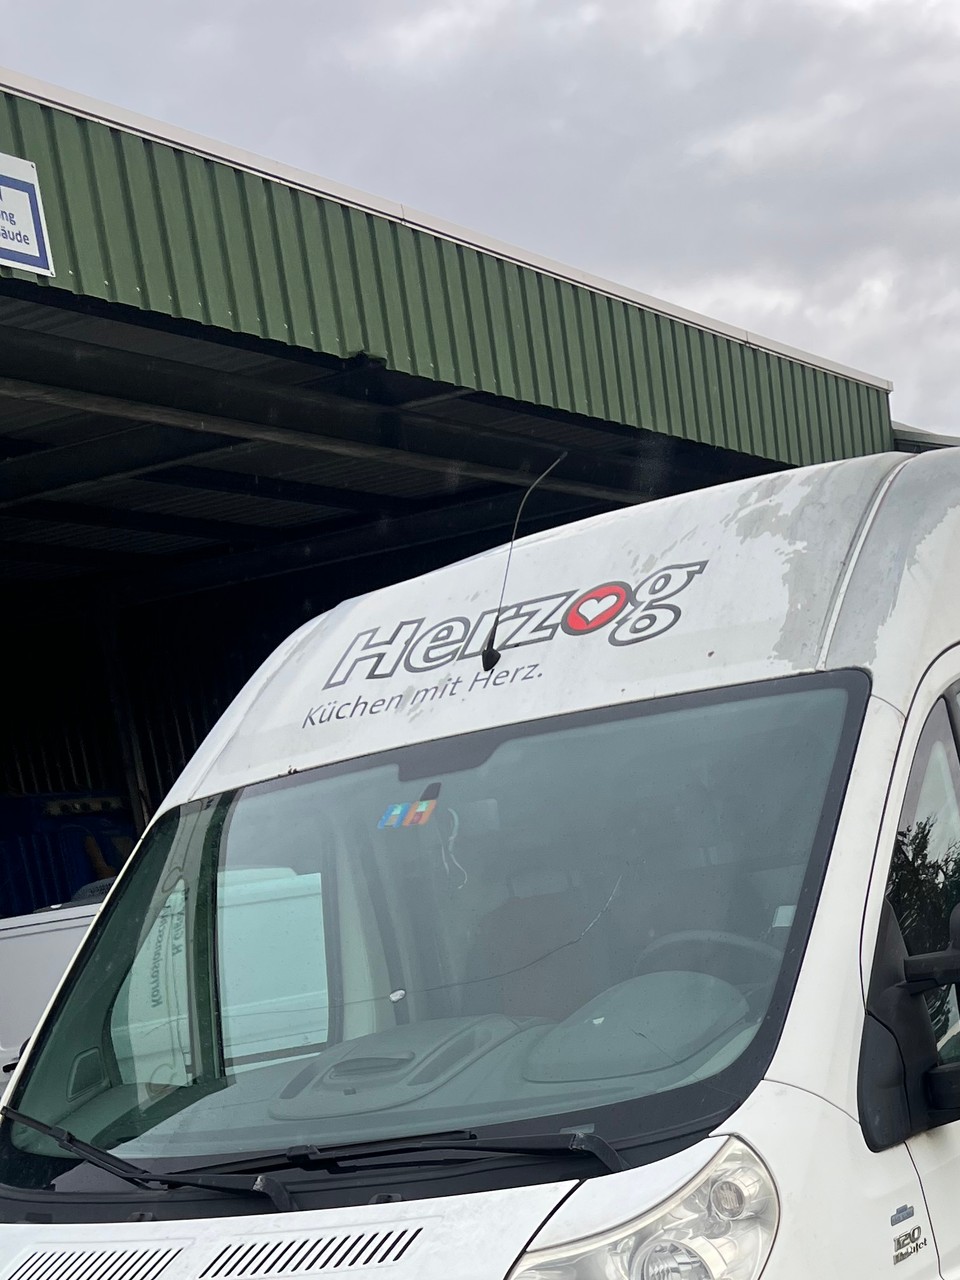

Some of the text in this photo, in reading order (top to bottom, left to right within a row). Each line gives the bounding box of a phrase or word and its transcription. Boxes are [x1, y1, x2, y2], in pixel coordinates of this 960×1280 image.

[322, 559, 710, 690] Herzog
[302, 660, 543, 729] Küchen mit Herz.
